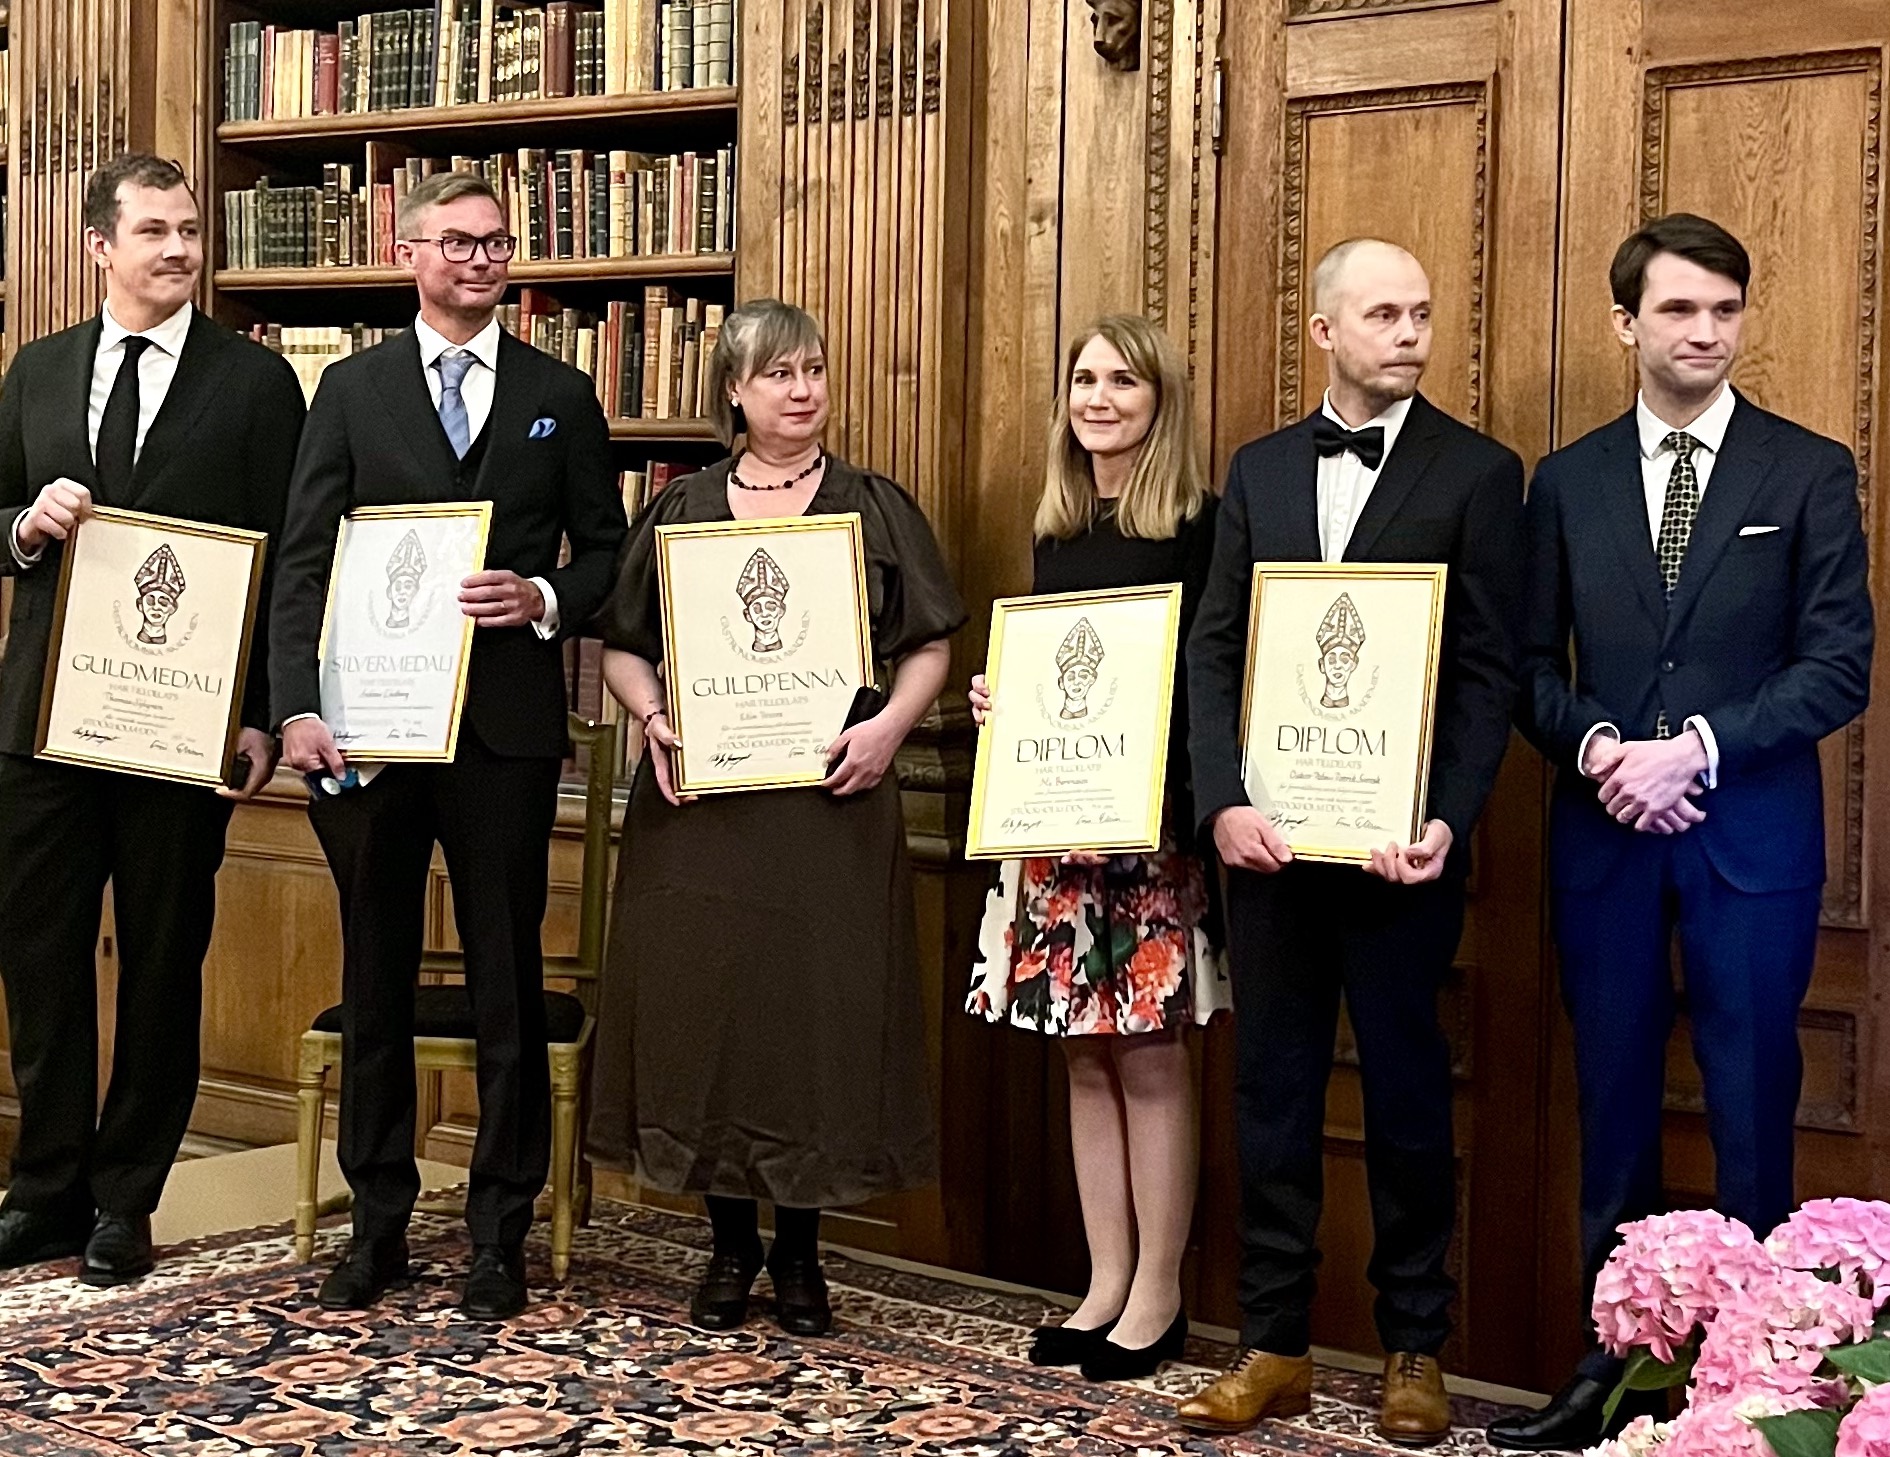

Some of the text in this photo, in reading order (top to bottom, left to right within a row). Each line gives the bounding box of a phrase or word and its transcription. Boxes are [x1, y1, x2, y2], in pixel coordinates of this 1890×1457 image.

[72, 654, 222, 696] GULDMEDALJ
[330, 655, 453, 673] SILVERMEDALJ
[693, 668, 847, 697] GULDPENNA
[1017, 733, 1124, 762] DIPLOM
[1277, 725, 1386, 756] DIPLOM
